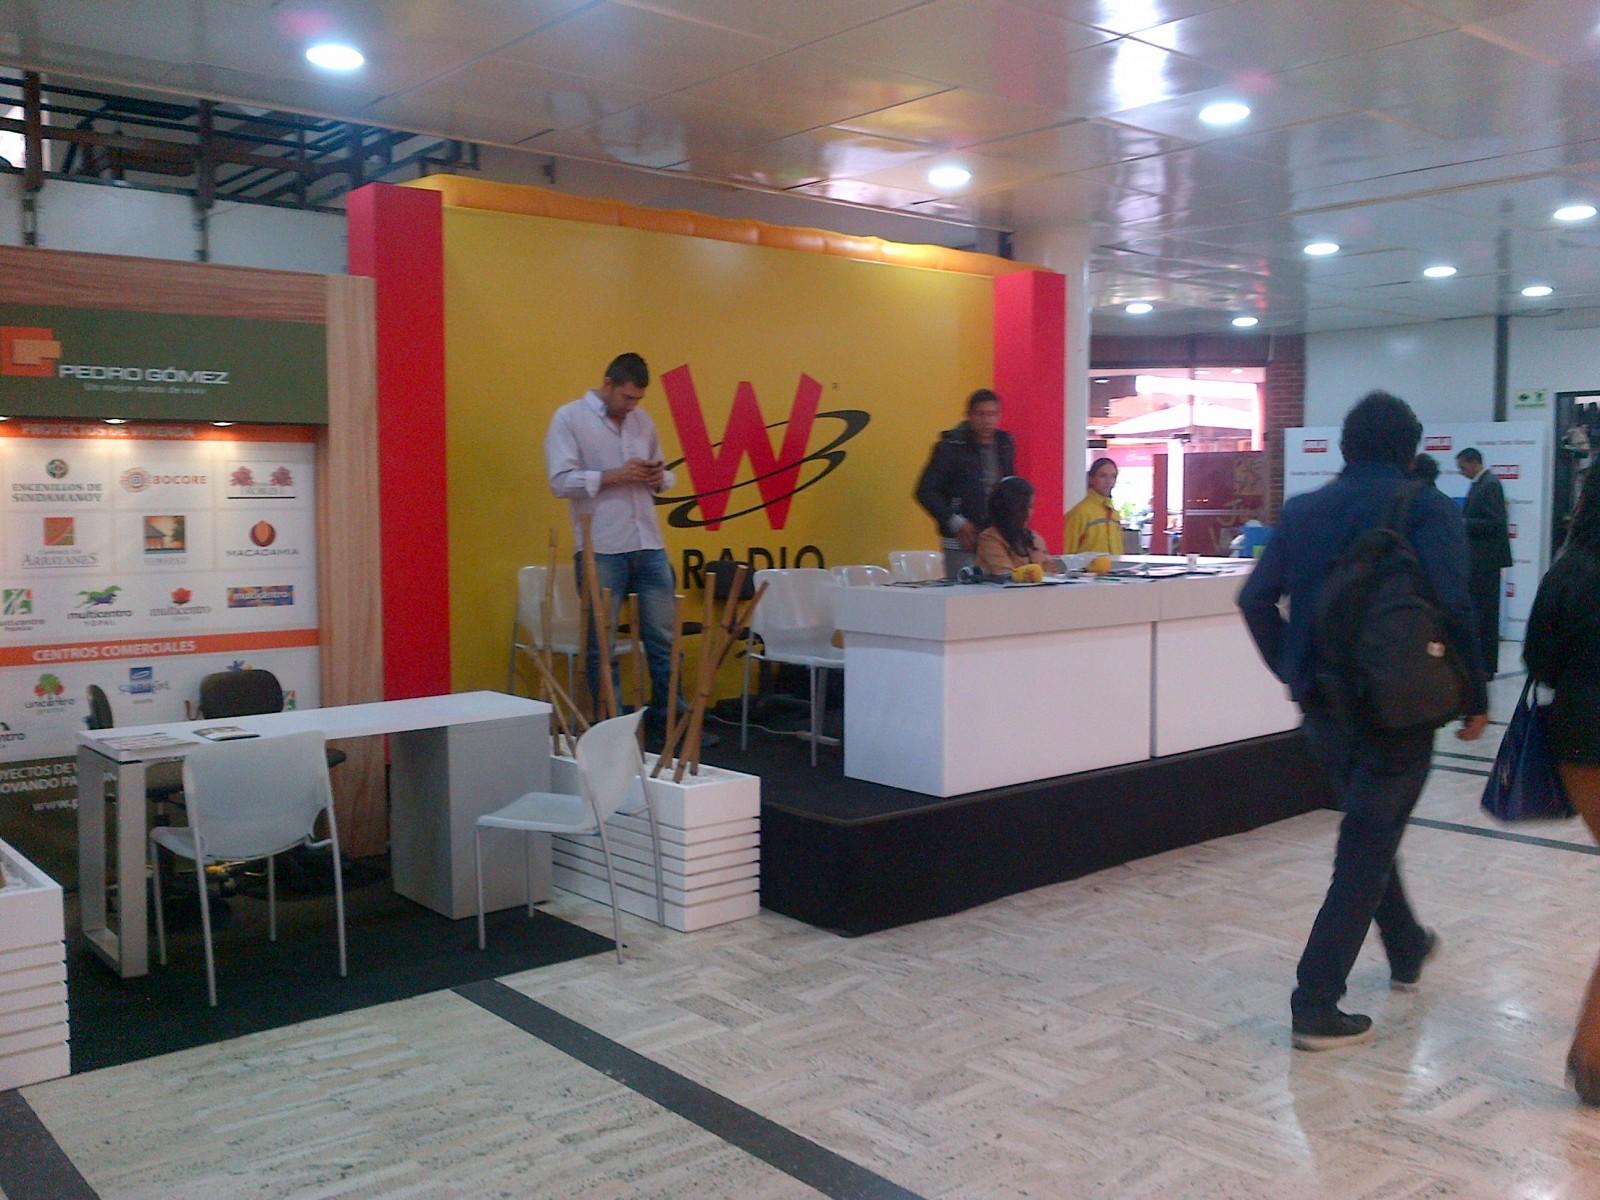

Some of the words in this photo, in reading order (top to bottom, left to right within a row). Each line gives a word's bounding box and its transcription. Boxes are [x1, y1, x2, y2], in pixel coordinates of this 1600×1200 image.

[59, 364, 142, 380] PEDRO
[144, 366, 230, 384] GÓMEZ
[660, 363, 823, 531] W
[152, 475, 208, 485] BOCORE
[67, 610, 132, 619] multicentro
[32, 646, 99, 661] CENTROS
[101, 640, 196, 657] COMERCIALES
